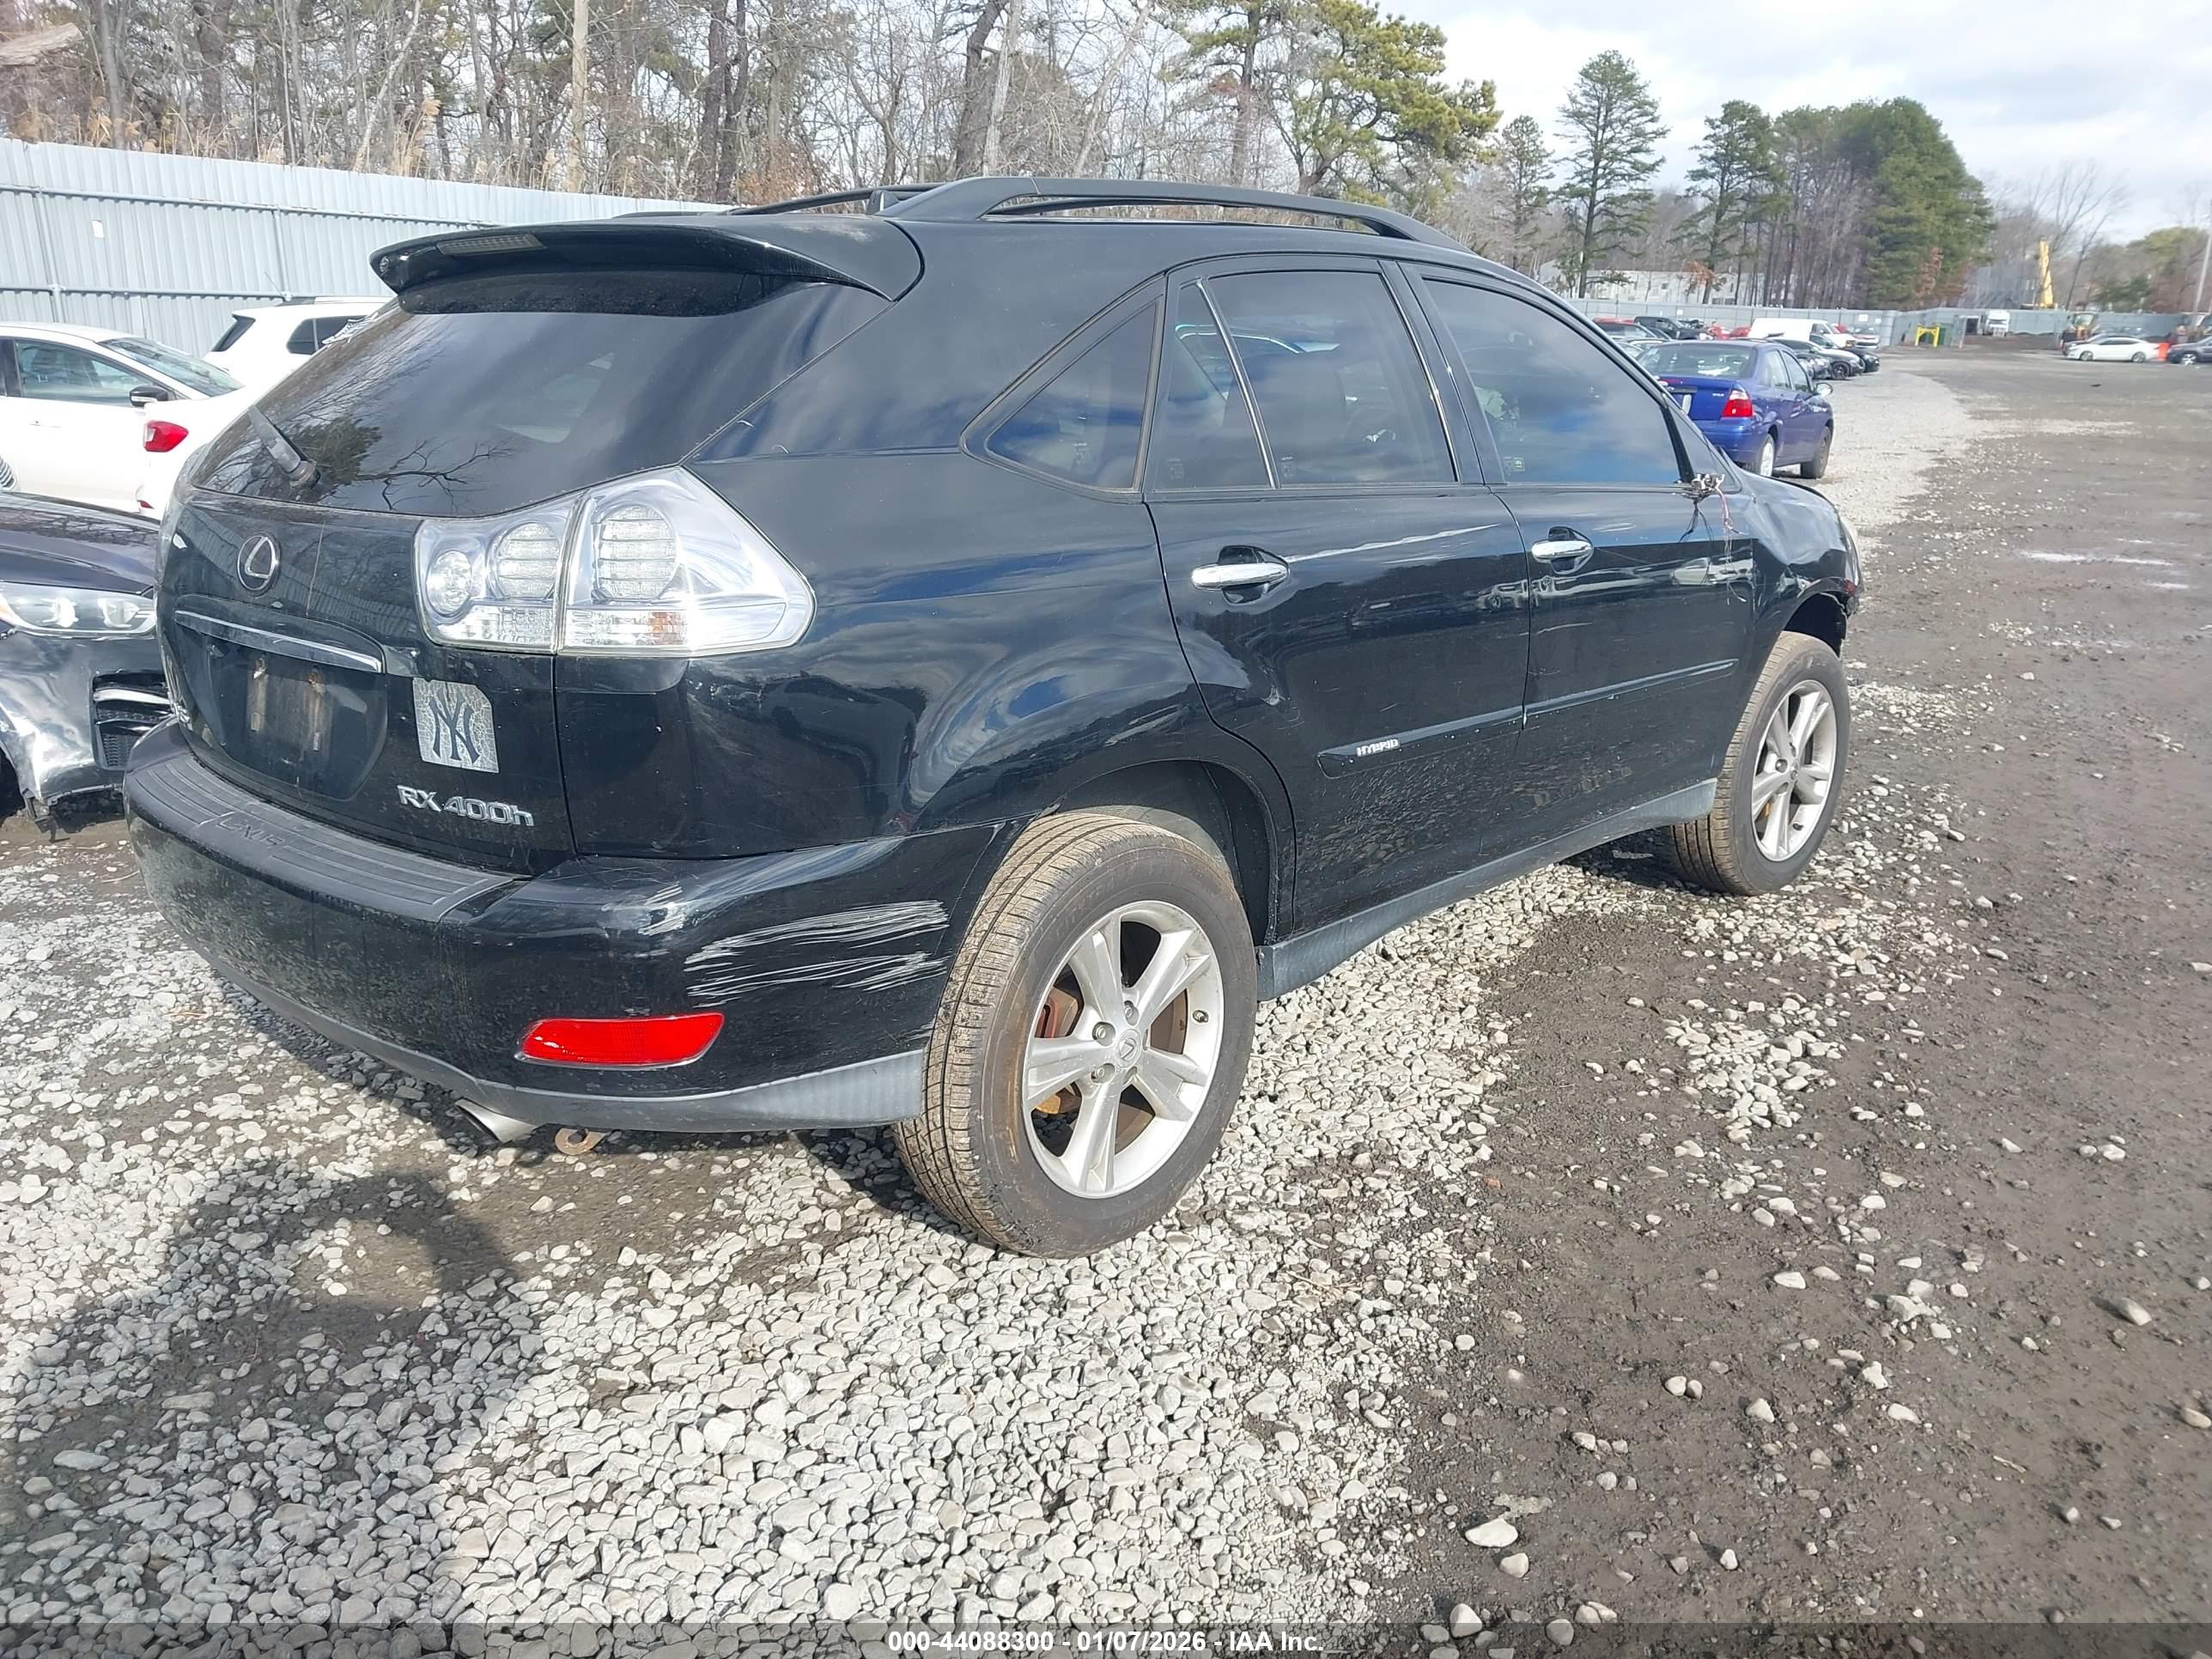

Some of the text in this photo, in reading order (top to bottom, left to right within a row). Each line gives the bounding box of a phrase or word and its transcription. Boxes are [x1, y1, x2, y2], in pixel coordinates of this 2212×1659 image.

[1357, 739, 1399, 757] HYBRID
[396, 784, 535, 827] RX 400h
